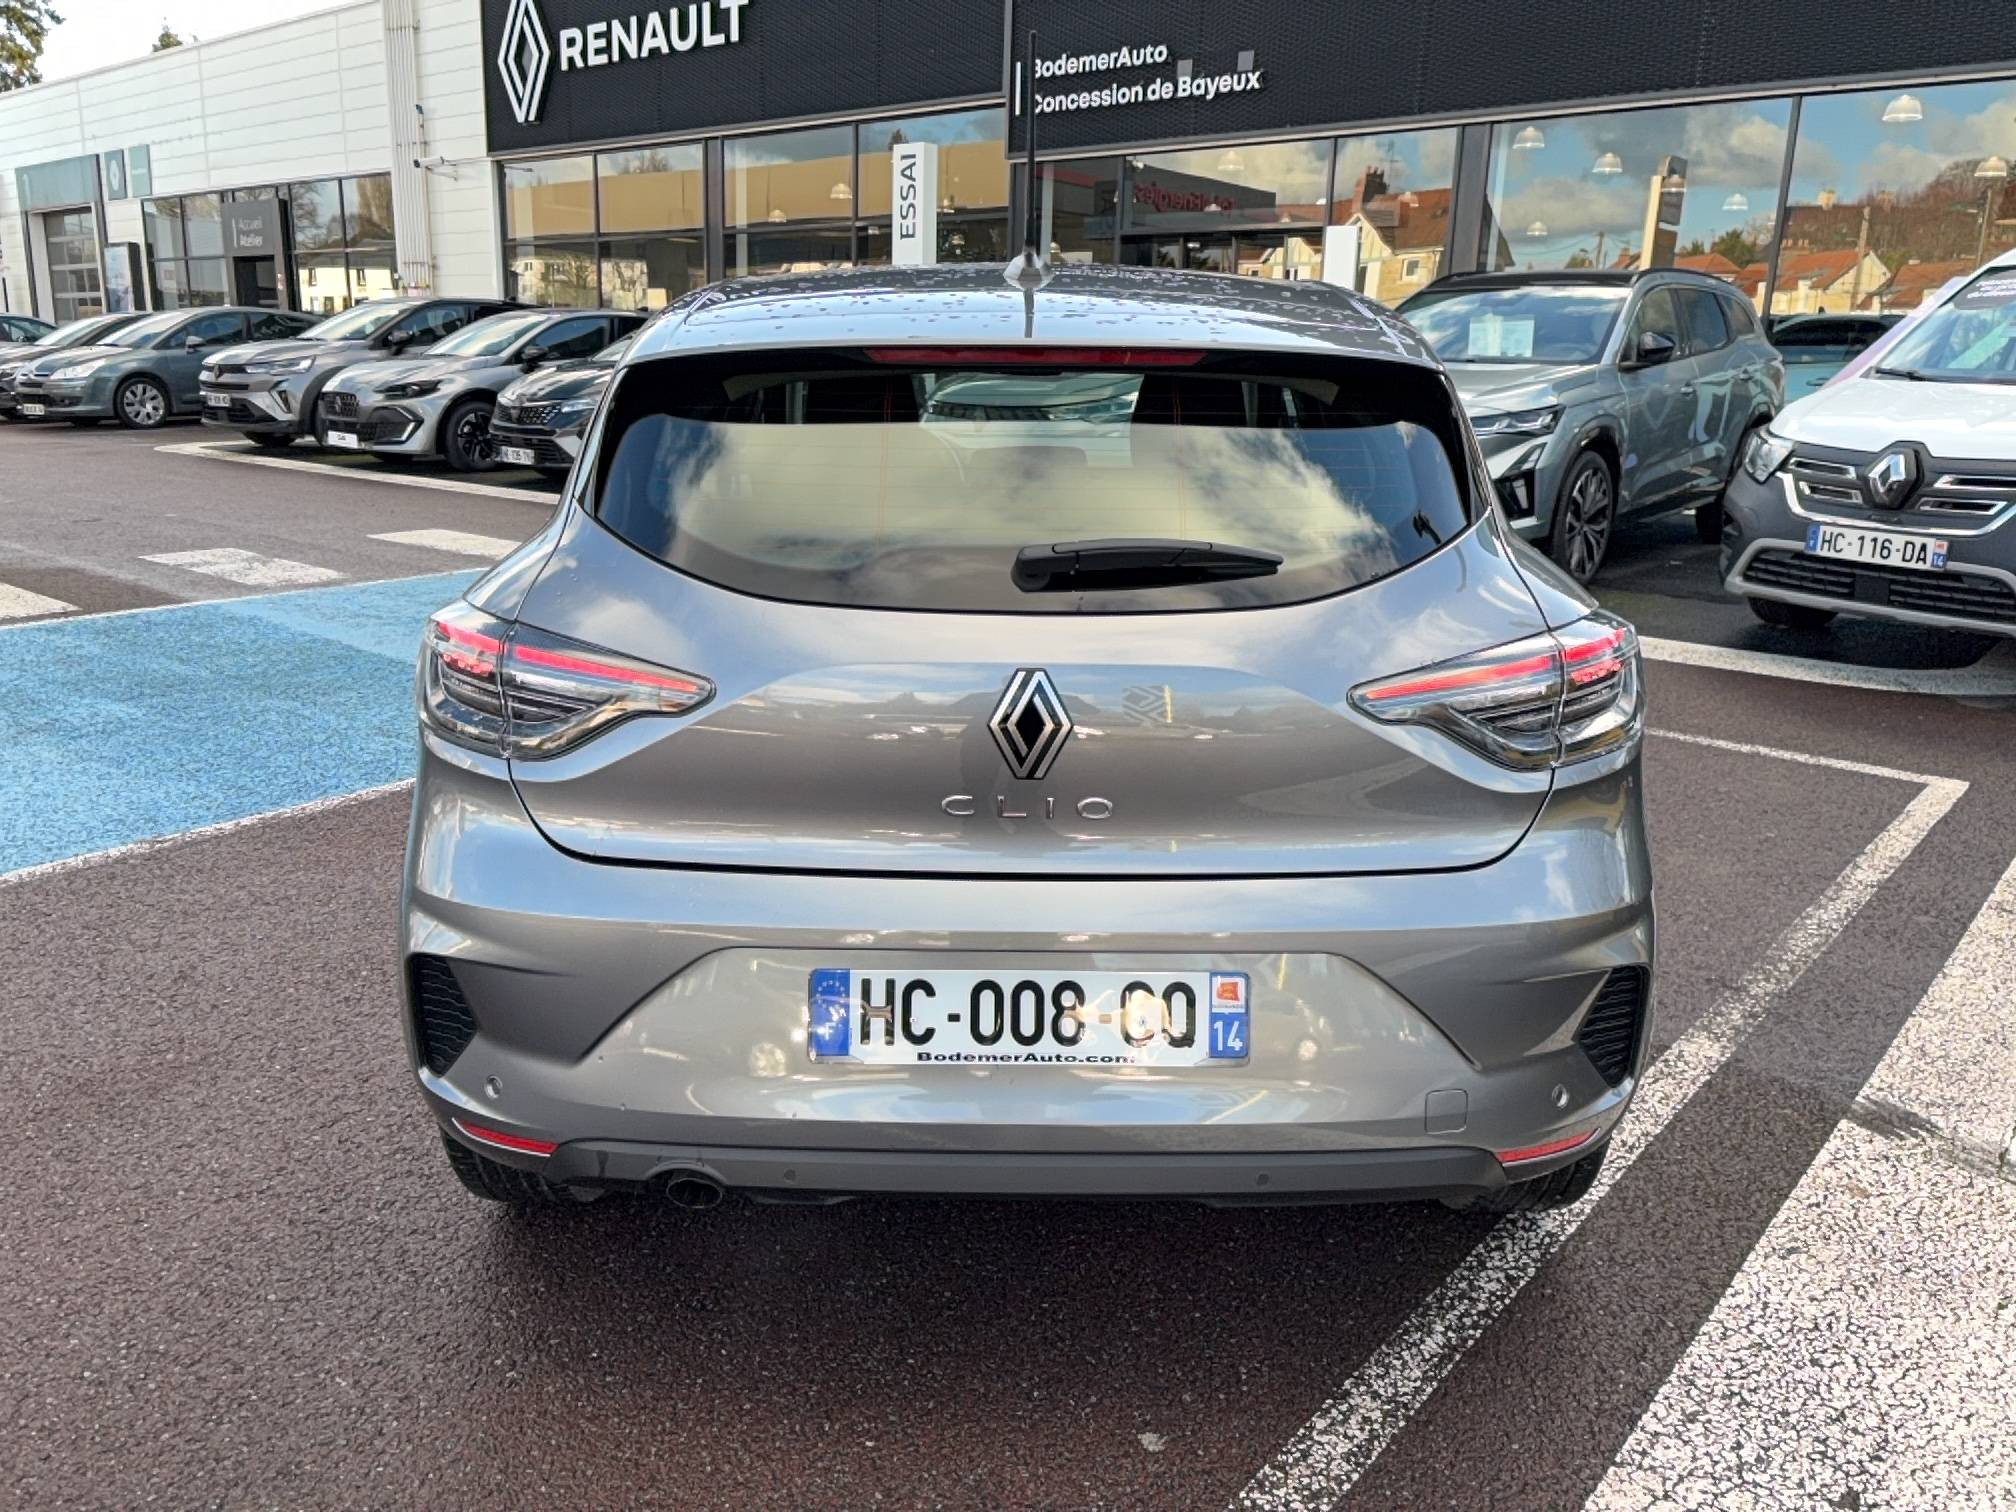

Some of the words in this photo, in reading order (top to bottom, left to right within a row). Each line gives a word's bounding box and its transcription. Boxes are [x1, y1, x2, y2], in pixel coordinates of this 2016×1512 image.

[559, 0, 749, 71] RENAULT
[1147, 77, 1174, 101] de
[1177, 70, 1261, 100] Bayeux
[900, 153, 917, 240] ESSAI
[1820, 530, 1928, 565] HC-116-DA
[1933, 553, 1944, 567] 14
[941, 794, 1113, 819] CLIO
[1213, 1021, 1243, 1051] 14
